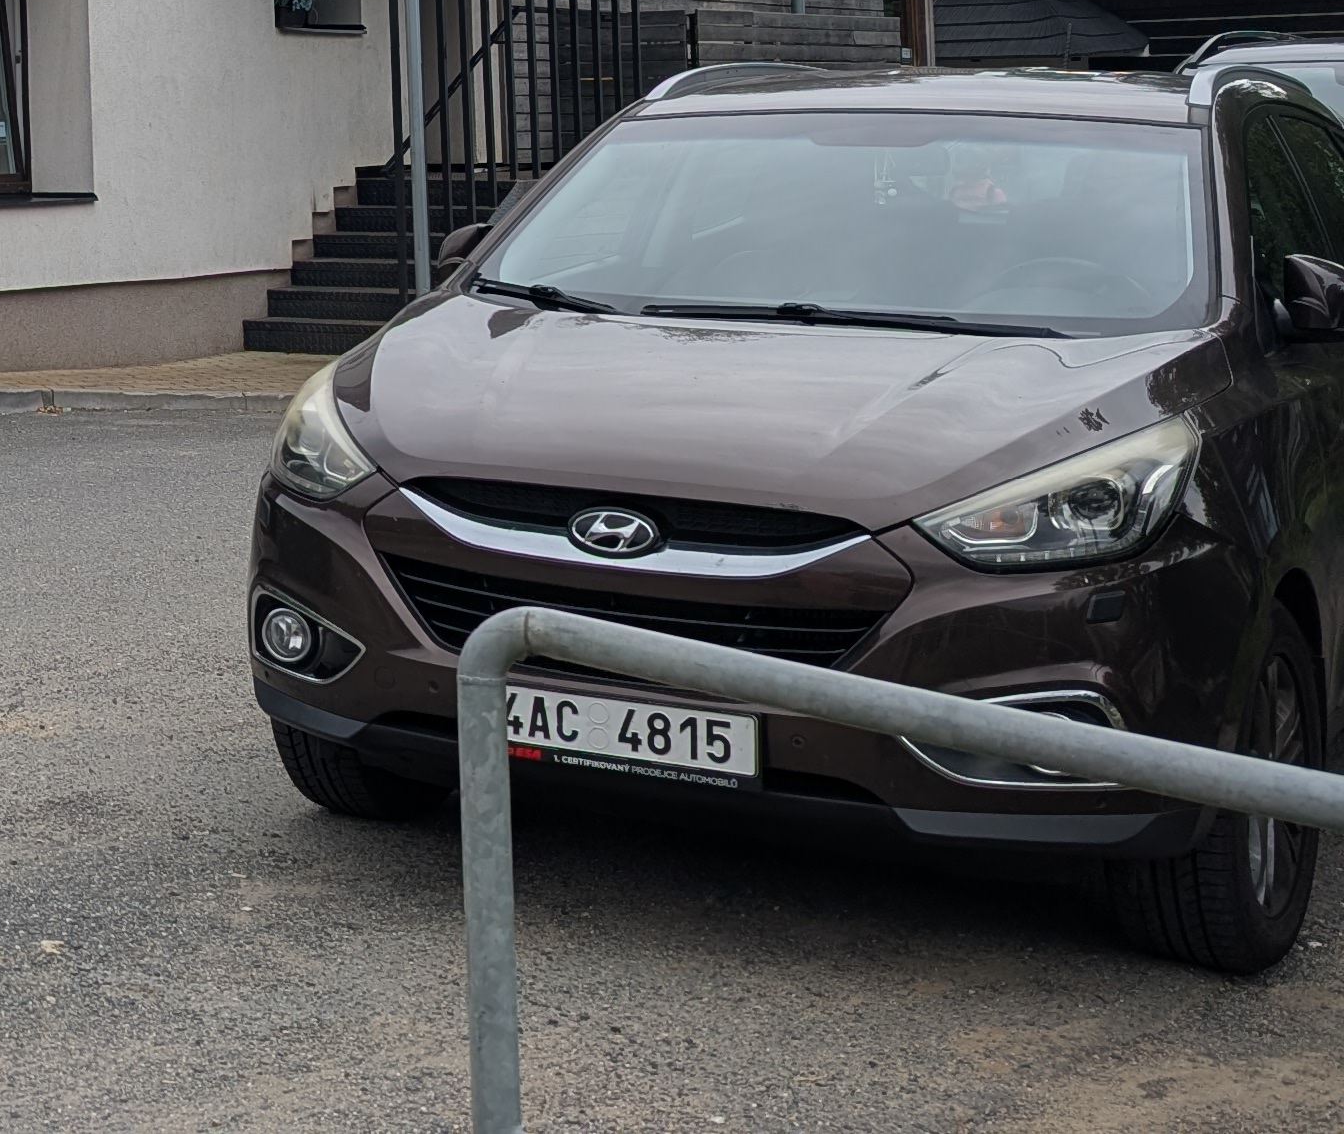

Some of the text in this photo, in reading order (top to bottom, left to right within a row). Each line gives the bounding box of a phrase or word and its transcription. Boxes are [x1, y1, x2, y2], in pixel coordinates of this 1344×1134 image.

[506, 692, 732, 764] 4AC 4815
[632, 765, 678, 780] PRODEJCE
